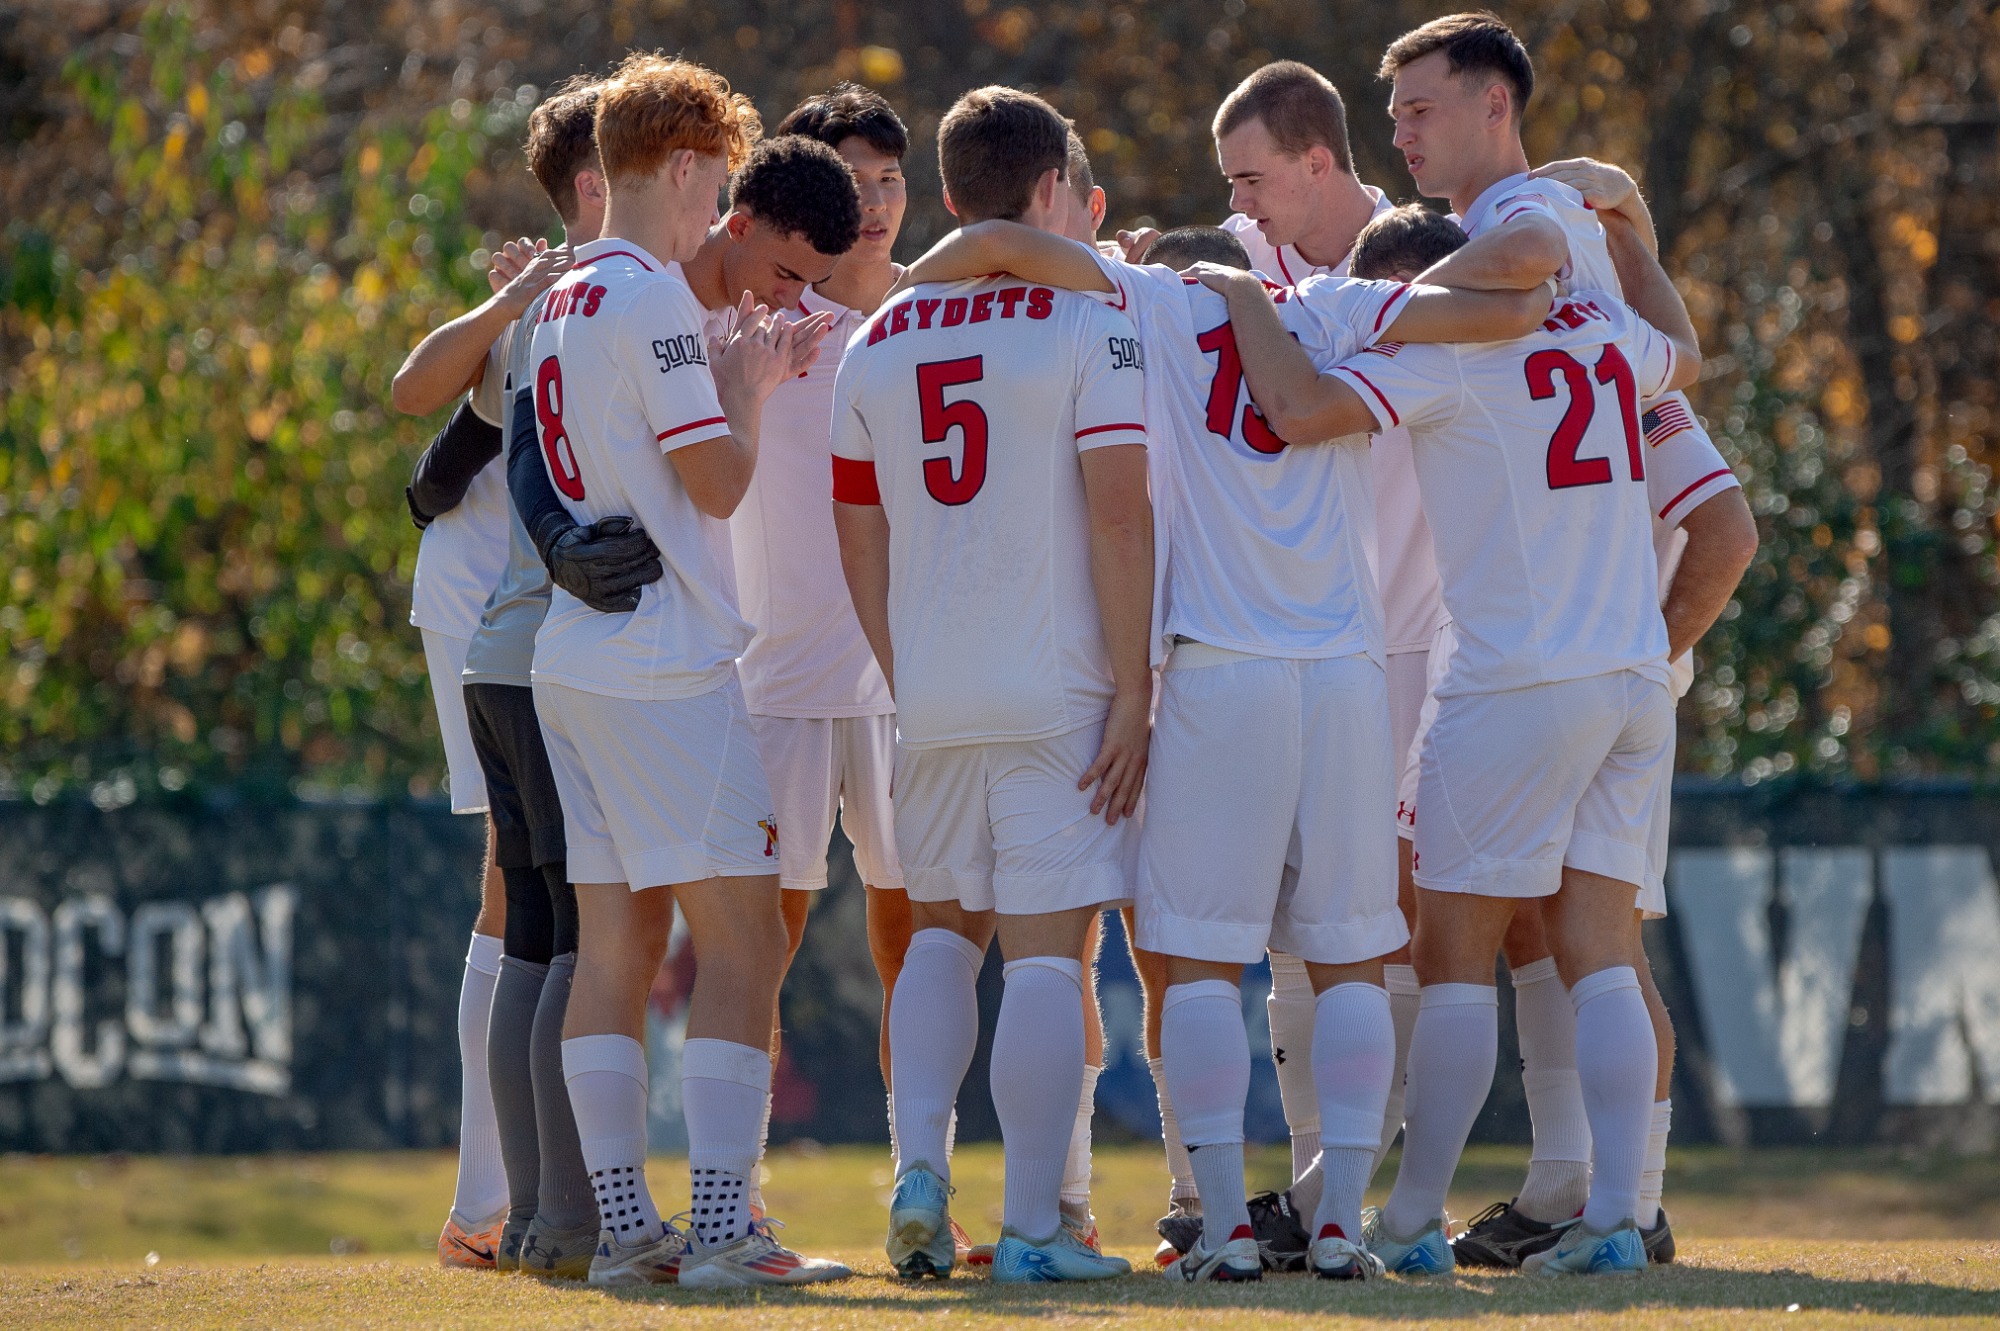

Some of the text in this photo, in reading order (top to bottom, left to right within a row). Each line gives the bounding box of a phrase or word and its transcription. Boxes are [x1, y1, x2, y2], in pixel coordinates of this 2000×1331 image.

[867, 287, 1055, 347] KEYDETS
[537, 354, 585, 501] 8
[916, 354, 988, 506] 5
[1524, 342, 1645, 489] 21
